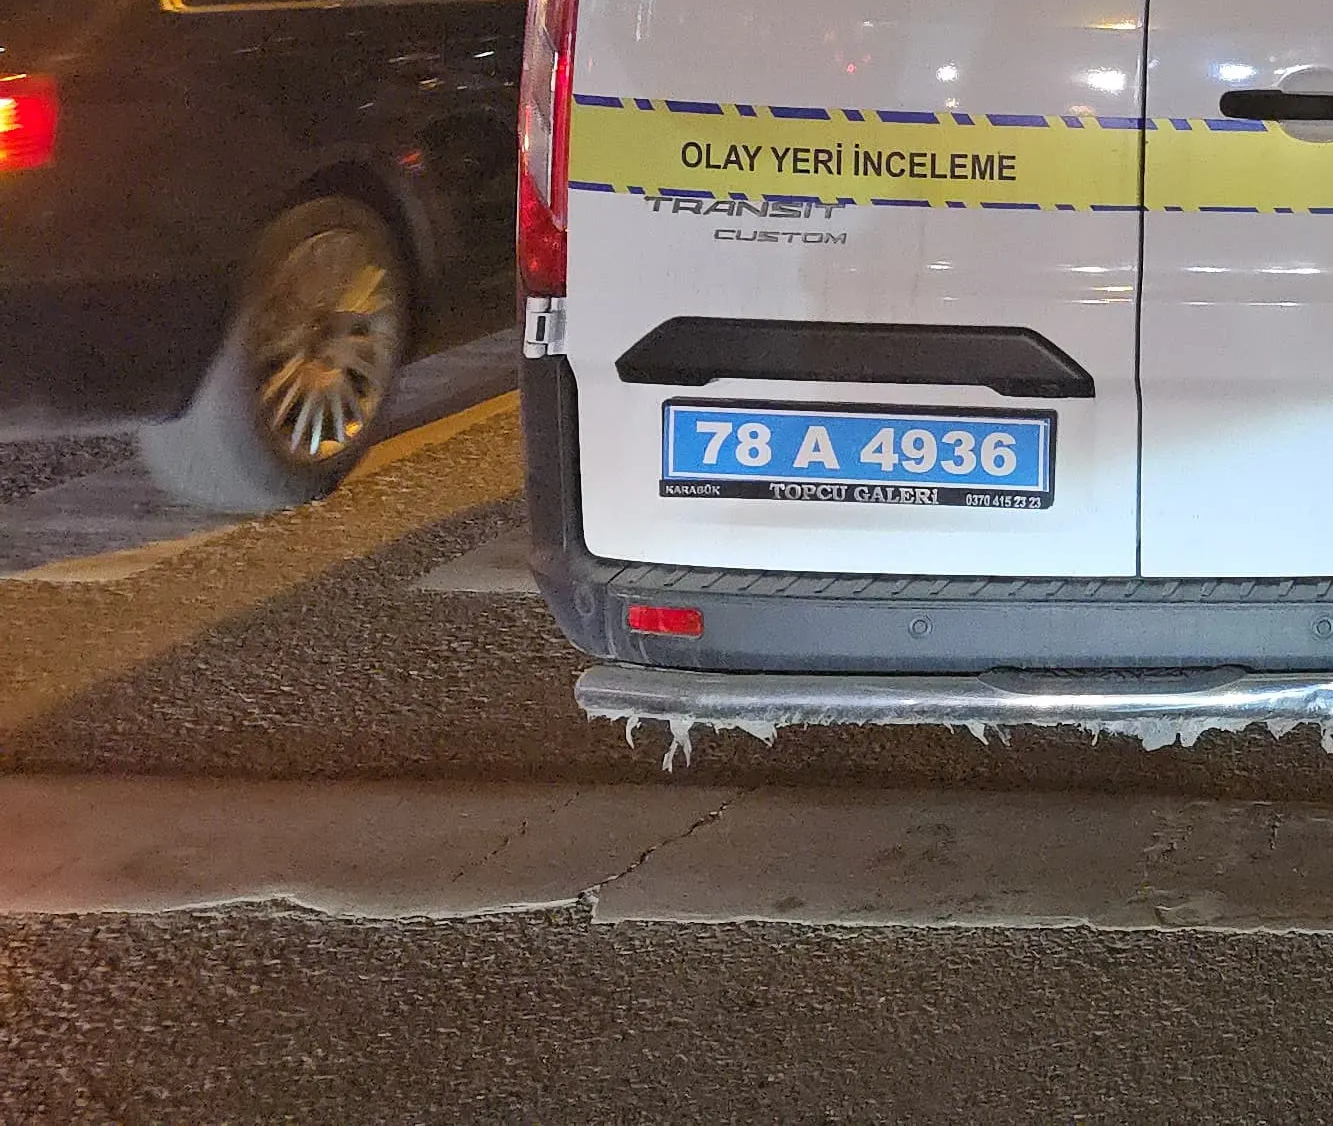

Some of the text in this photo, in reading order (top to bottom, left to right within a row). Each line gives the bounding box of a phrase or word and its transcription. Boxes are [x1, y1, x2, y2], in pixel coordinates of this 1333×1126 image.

[680, 141, 1018, 181] OLAY YERİ İNCELEME
[644, 195, 846, 220] TRANSIT
[714, 229, 848, 245] CUSTOM
[696, 420, 1018, 477] 78 A 4936
[769, 482, 848, 500] TOPCU
[965, 493, 990, 507] 0370
[992, 494, 1012, 508] 415
[1013, 495, 1027, 508] 23
[1028, 496, 1042, 509] 23
